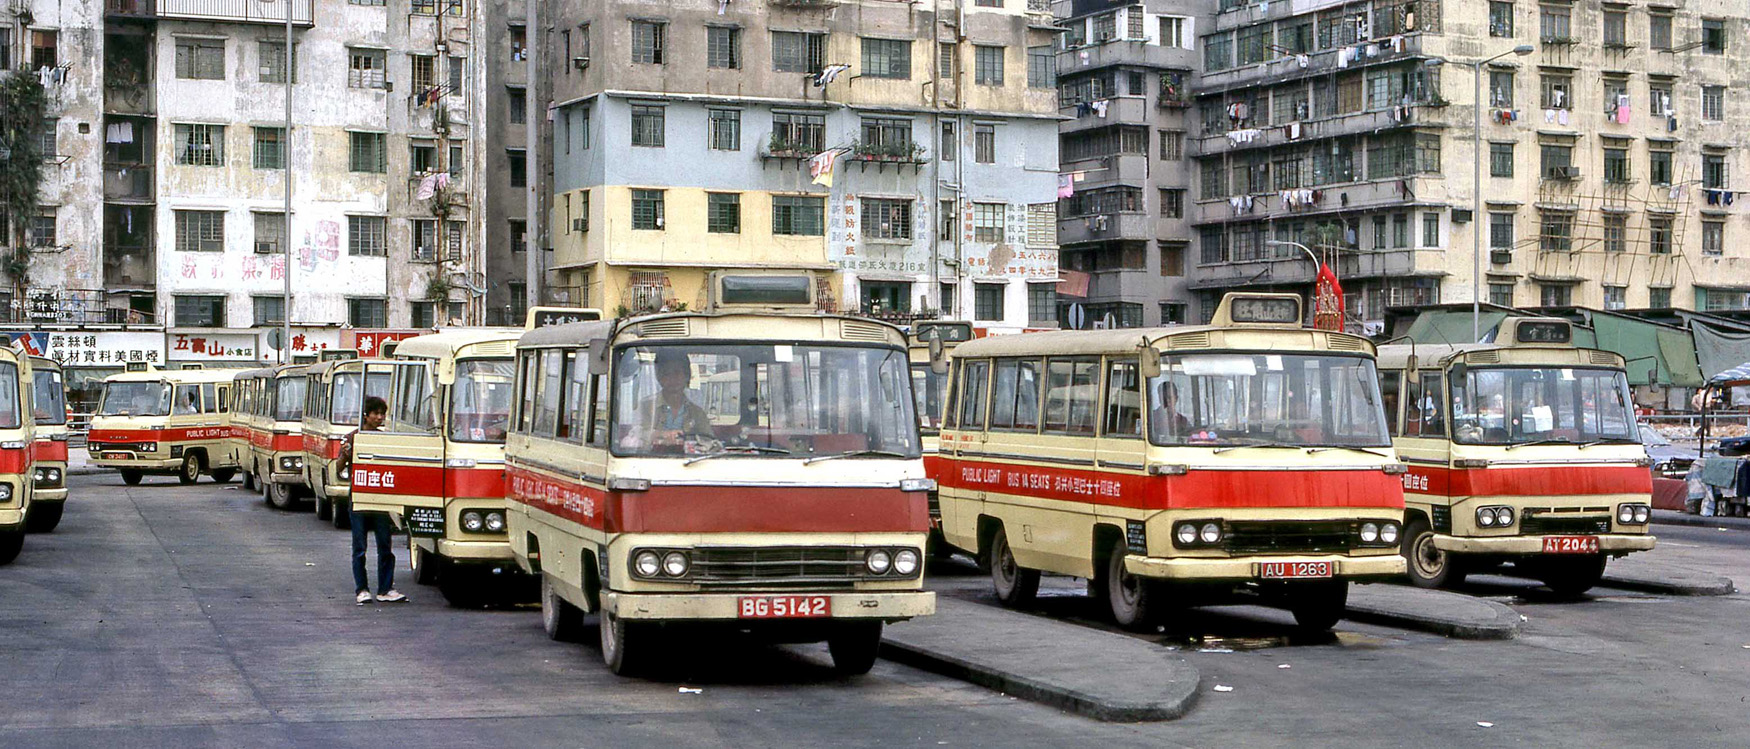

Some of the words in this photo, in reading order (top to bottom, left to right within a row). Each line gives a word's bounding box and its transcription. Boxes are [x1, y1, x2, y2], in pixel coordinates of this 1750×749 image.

[51, 335, 97, 349] 雲絲頓
[226, 348, 253, 357] 小食店
[186, 430, 204, 438] PUBLIC
[205, 428, 220, 437] LIGHT
[962, 467, 982, 483] PUBLIC
[983, 468, 1001, 484] LIGHT
[1007, 473, 1020, 488] BUS
[1030, 474, 1050, 490] SEATS
[1546, 538, 1561, 552] AT
[1562, 538, 1597, 551] 2044
[1265, 563, 1285, 577] AU
[1291, 562, 1327, 576] 1263
[741, 598, 768, 617] BG
[772, 596, 826, 616] 5142
